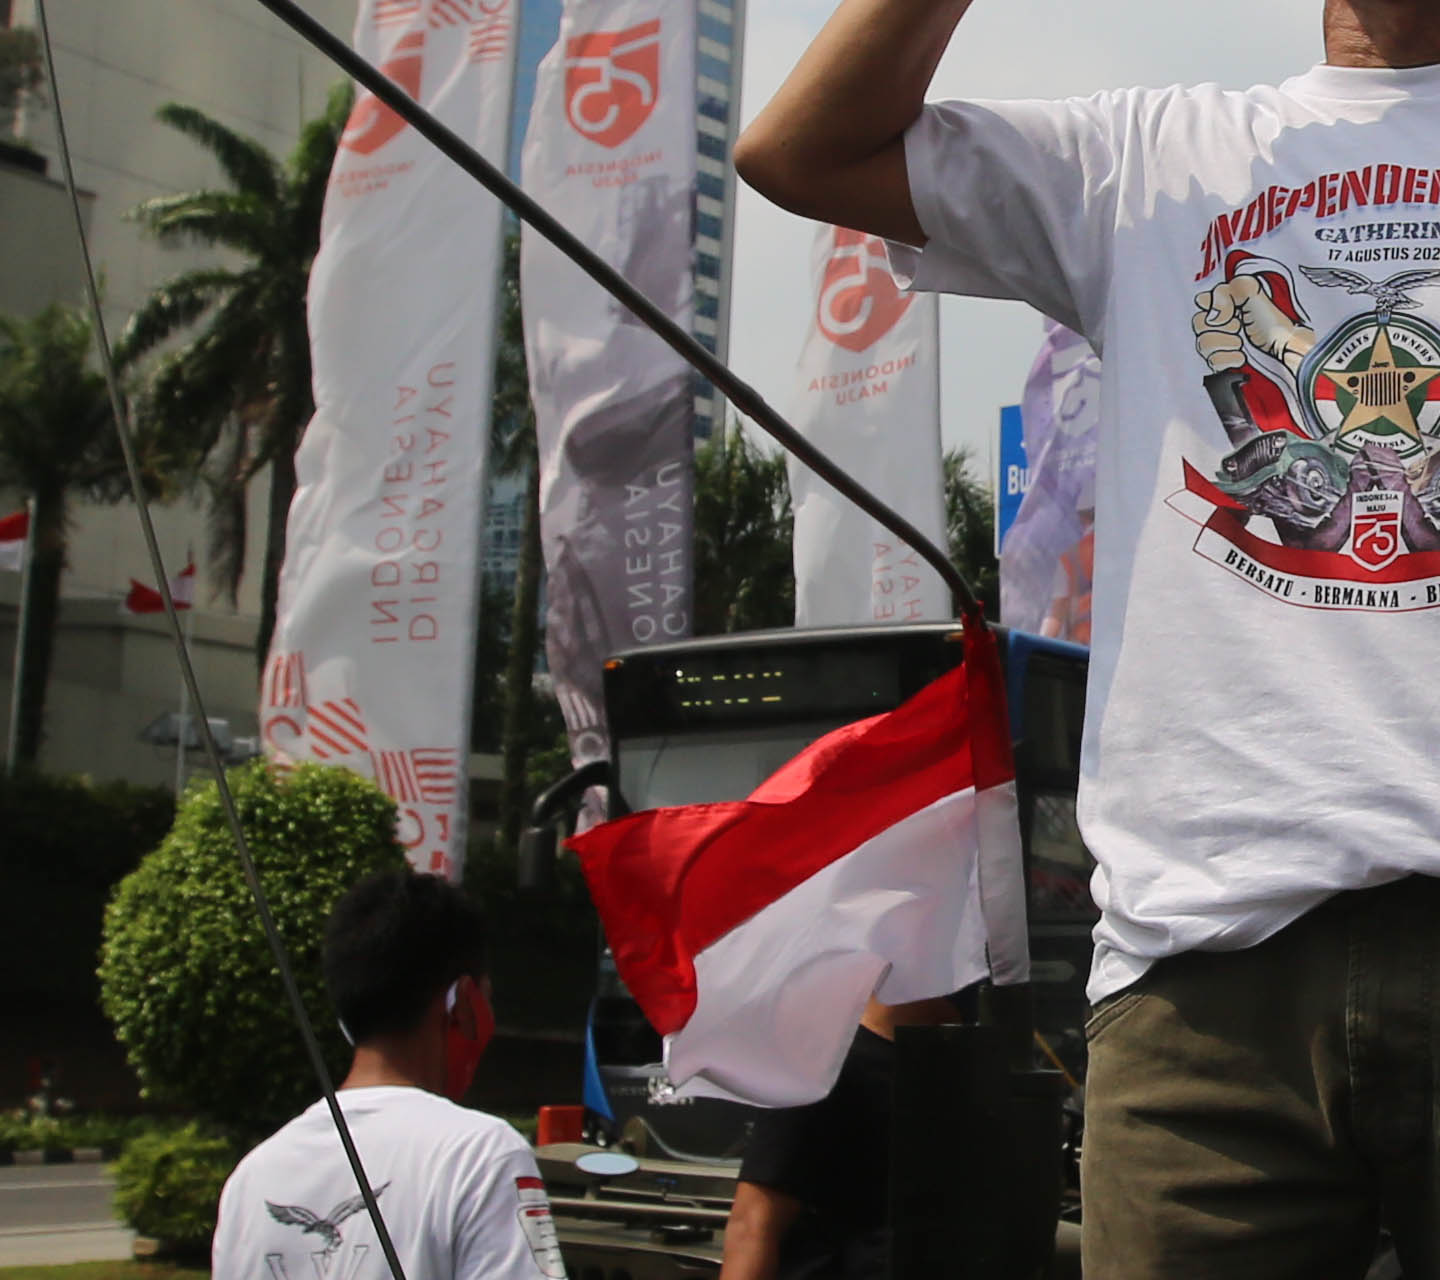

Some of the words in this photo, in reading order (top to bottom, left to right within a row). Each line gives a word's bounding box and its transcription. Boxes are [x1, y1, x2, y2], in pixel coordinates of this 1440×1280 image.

[1328, 249, 1342, 261] 17
[1345, 247, 1410, 263] AGUSTUS
[1335, 332, 1370, 365] WILLYS
[1392, 332, 1435, 363] OWNERS
[1356, 492, 1400, 504] INDONESIA
[1366, 504, 1387, 513] MAJU
[1355, 518, 1395, 557] 75
[1224, 548, 1294, 597] BERSATU
[1314, 584, 1400, 608] BERMAKNA
